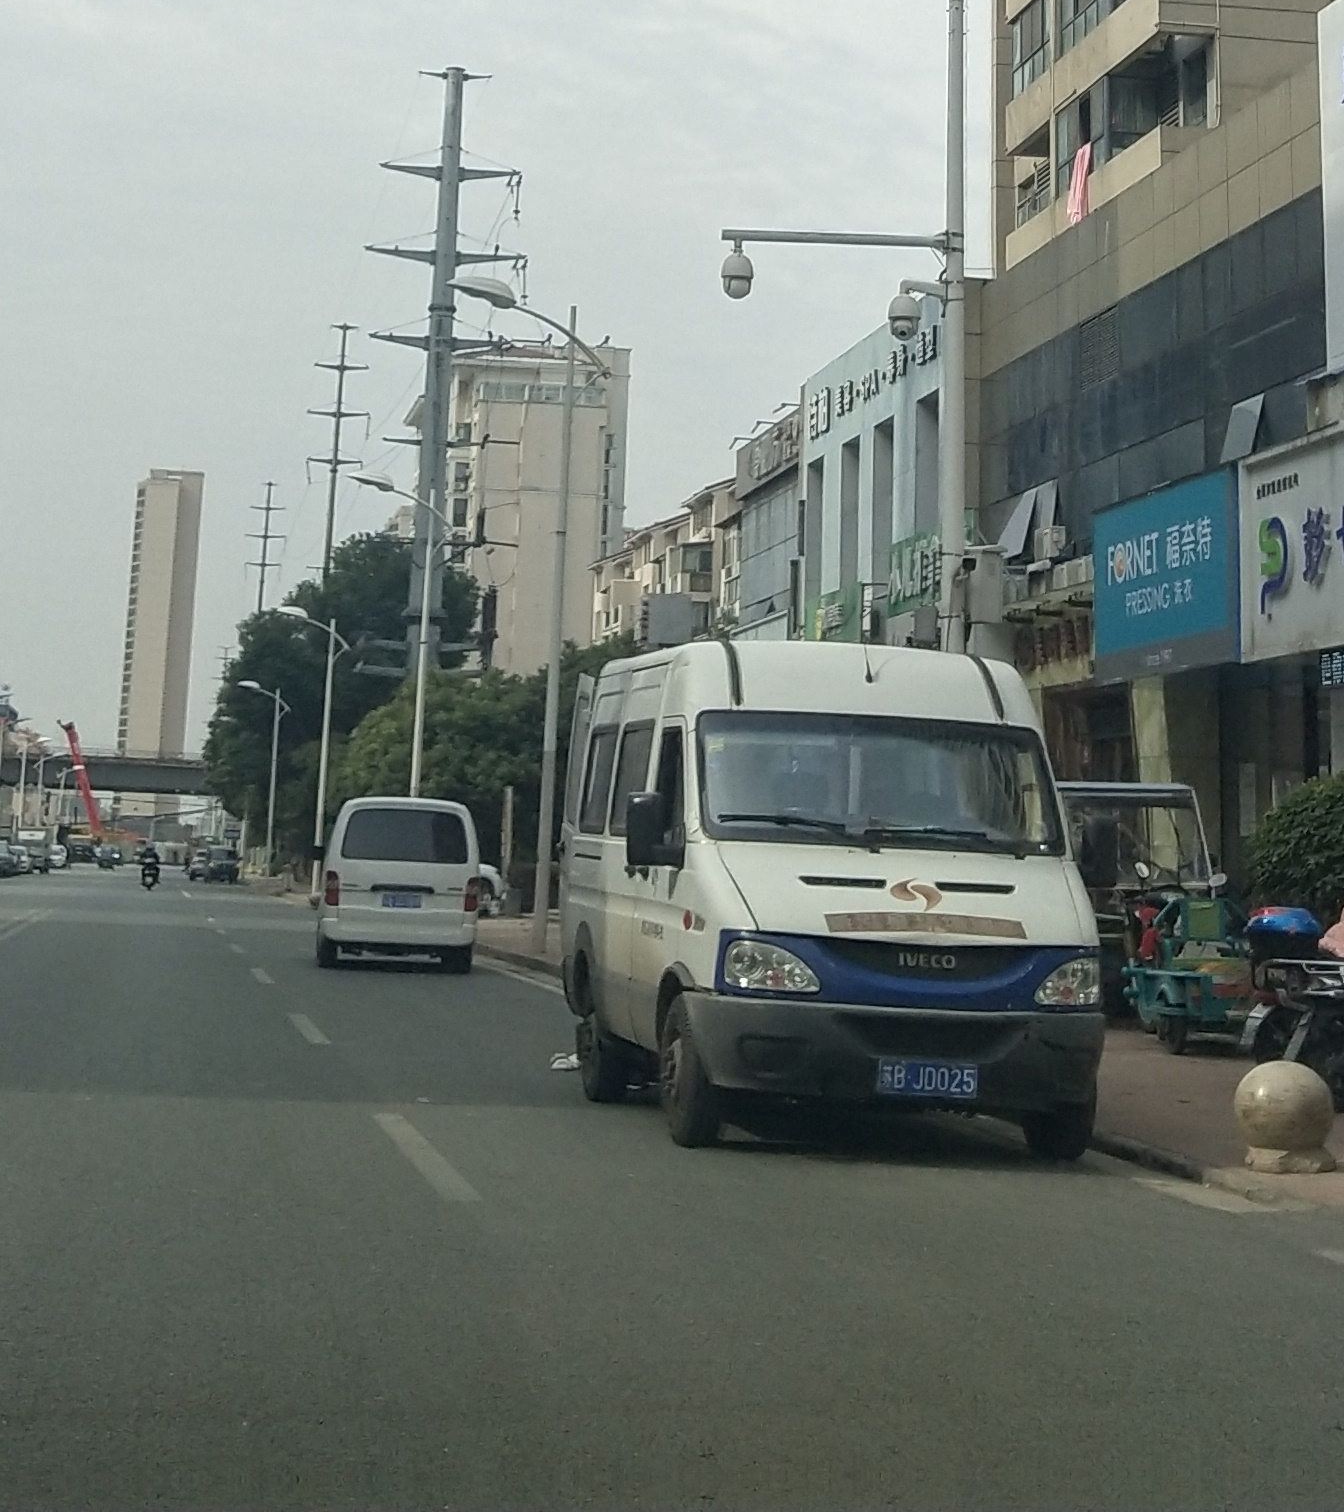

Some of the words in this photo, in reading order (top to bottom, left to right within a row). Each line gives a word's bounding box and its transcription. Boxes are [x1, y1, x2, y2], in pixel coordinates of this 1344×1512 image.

[1107, 531, 1160, 586] FORNET
[1166, 515, 1213, 569] 福奈特
[897, 951, 957, 970] IVECO
